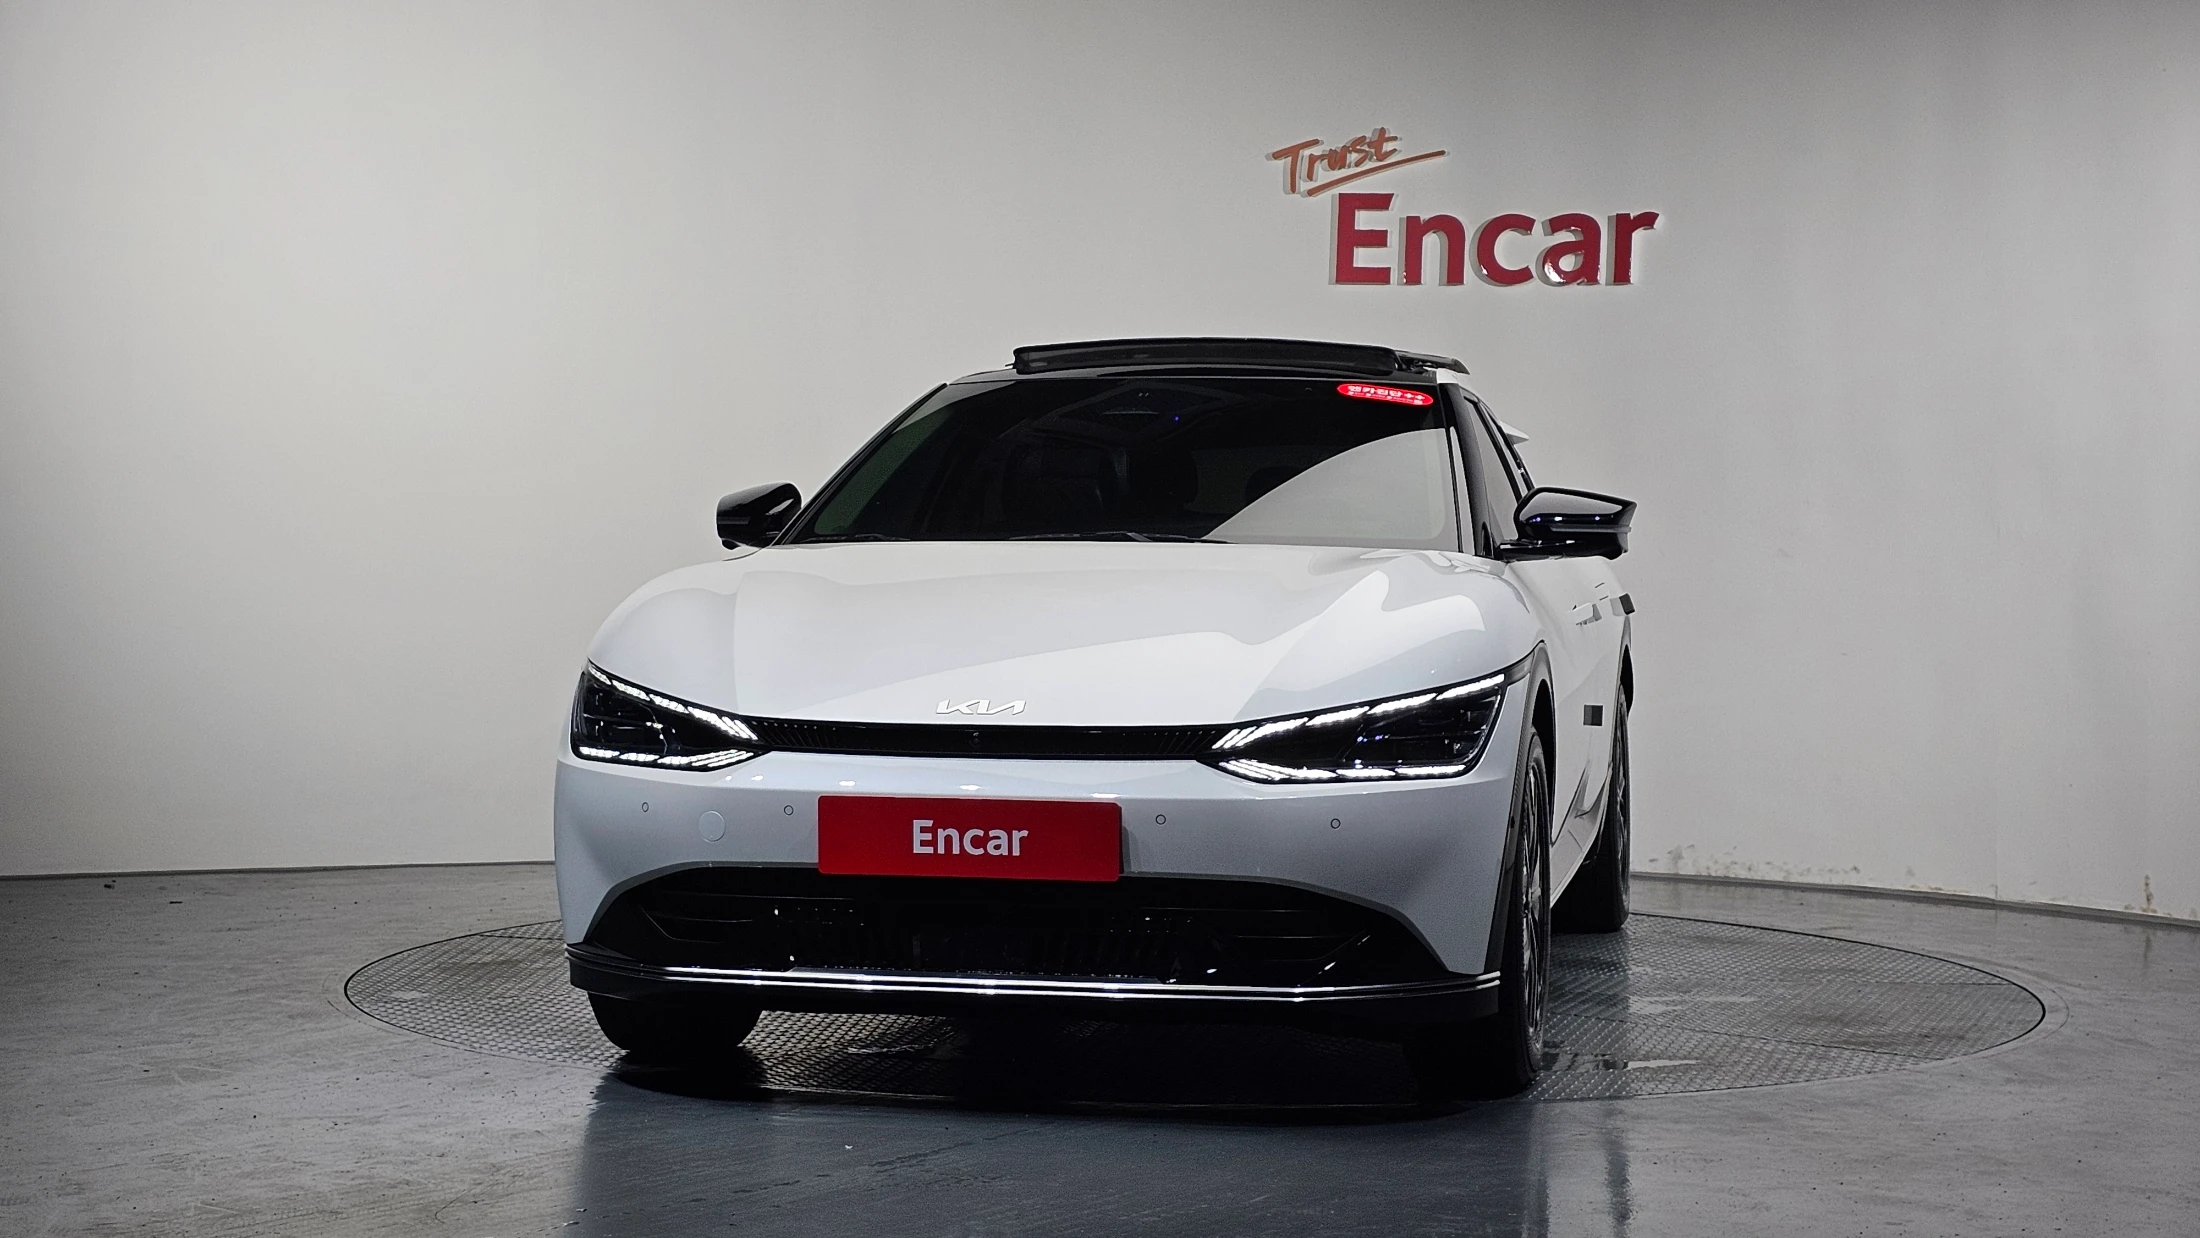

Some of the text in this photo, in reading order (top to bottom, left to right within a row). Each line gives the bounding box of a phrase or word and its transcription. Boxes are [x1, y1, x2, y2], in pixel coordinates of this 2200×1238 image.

[1271, 127, 1398, 194] Trust
[1333, 192, 1660, 286] Encar
[936, 699, 1027, 716] KIA
[912, 819, 1029, 857] Encar
